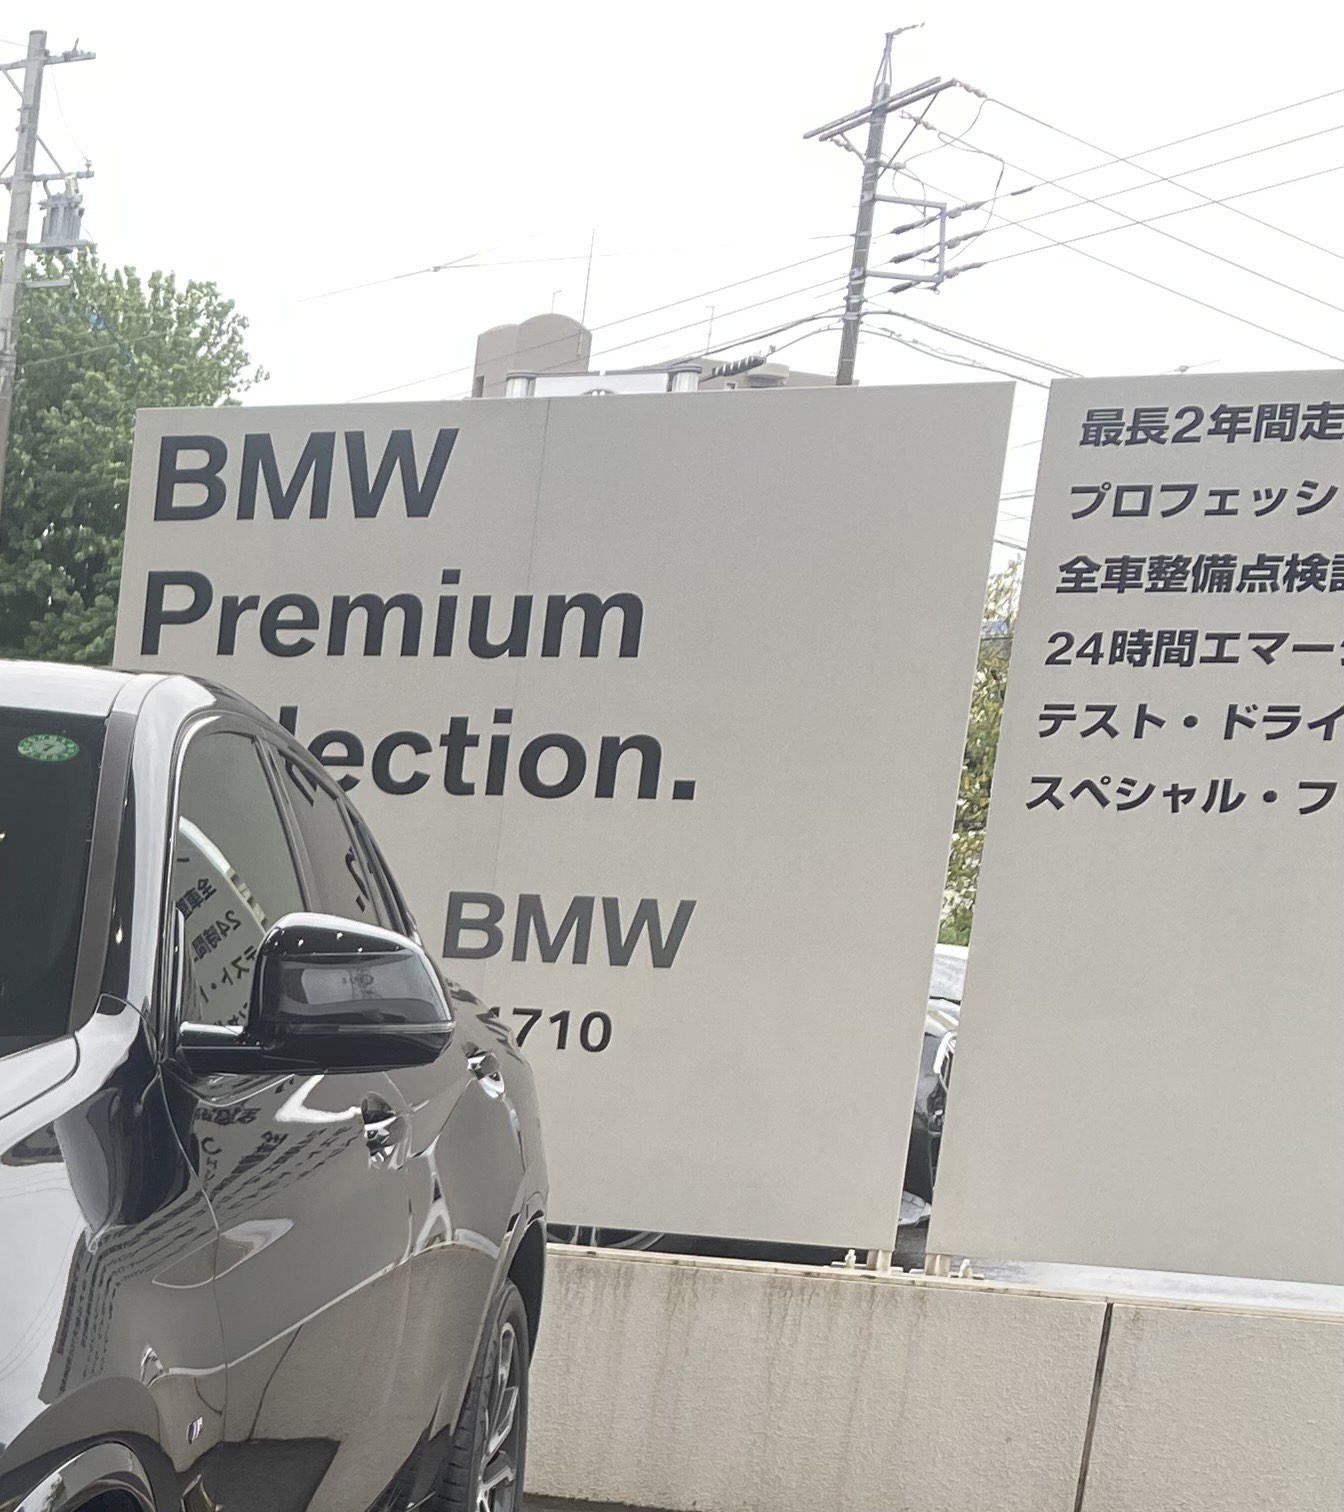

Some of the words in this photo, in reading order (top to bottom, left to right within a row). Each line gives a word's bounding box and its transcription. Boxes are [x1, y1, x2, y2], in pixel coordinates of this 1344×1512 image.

[1079, 400, 1344, 448] 最長2年間走
[153, 427, 460, 521] BMW
[1070, 480, 1339, 520] プロフェッシ
[139, 569, 644, 659] Premium
[1044, 628, 1344, 668] 24時間エマー
[1038, 702, 1344, 741] テスト・ドライ
[1026, 774, 1338, 815] スペシャル・フ
[442, 891, 698, 969] BMW
[486, 1006, 612, 1053] 710
